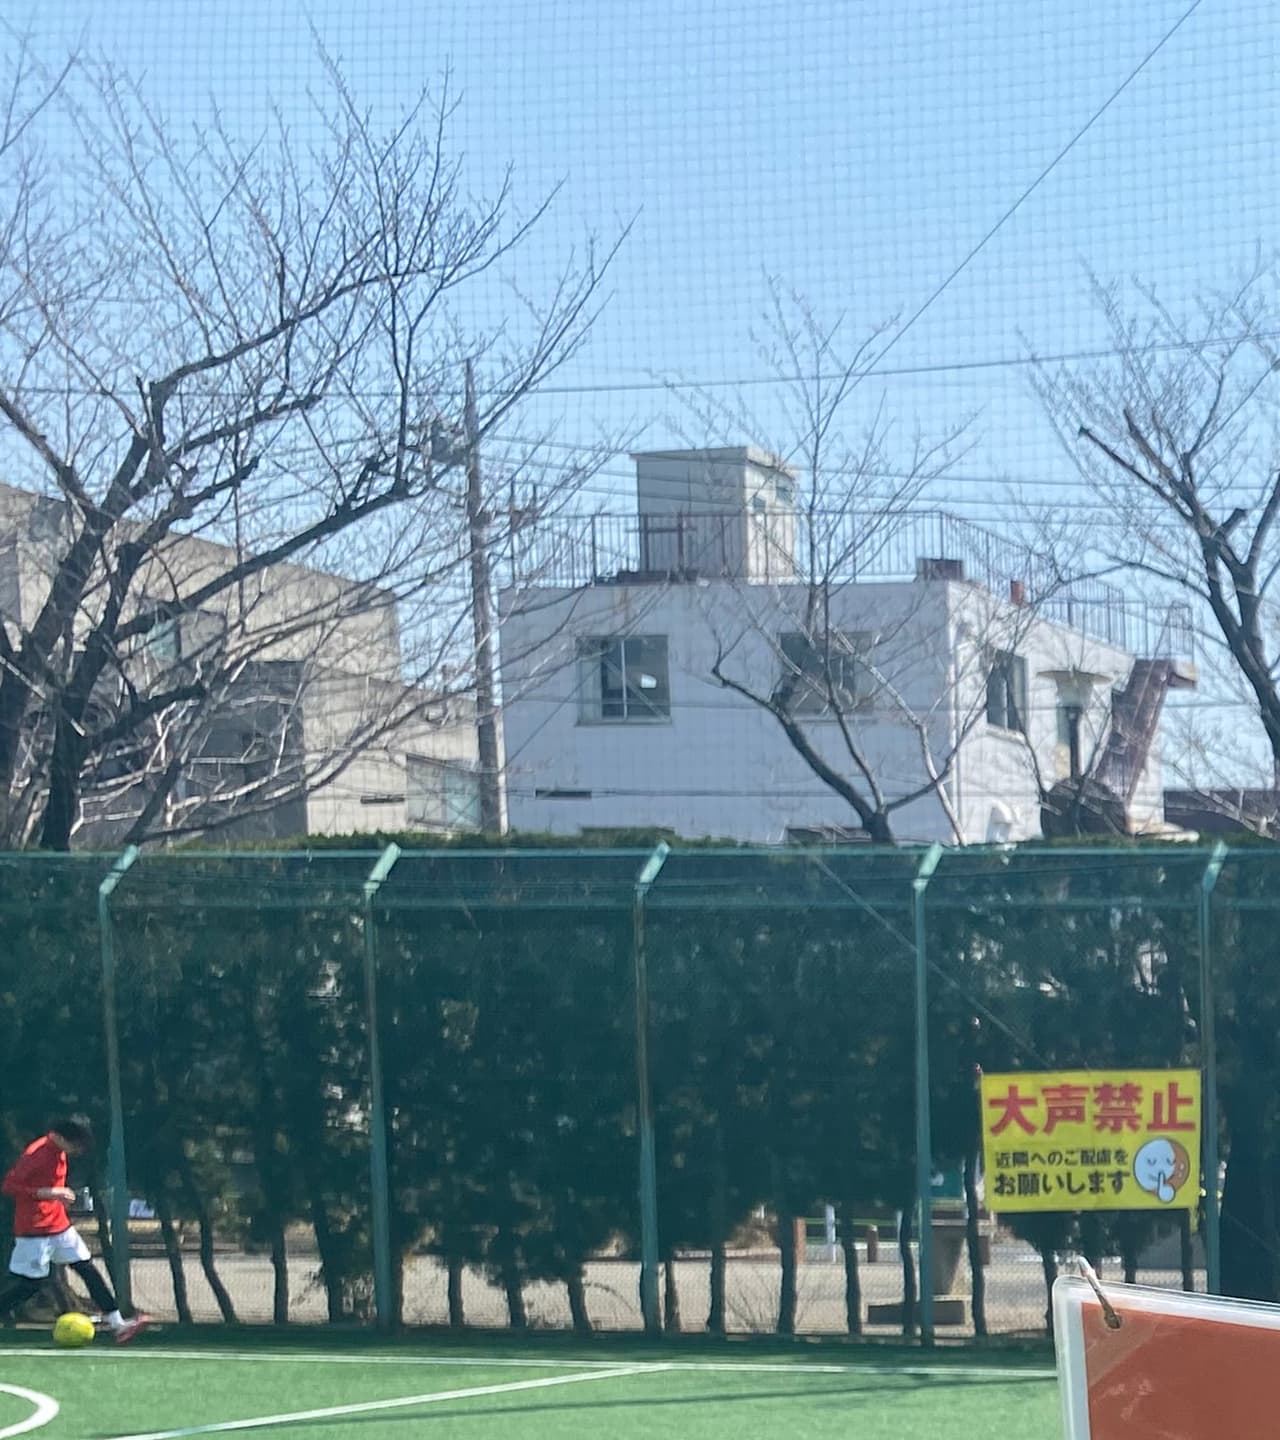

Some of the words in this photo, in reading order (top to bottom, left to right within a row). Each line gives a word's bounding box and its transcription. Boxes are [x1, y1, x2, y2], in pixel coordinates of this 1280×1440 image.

[989, 1082, 1196, 1135] 大声禁止
[995, 1149, 1129, 1169] 近隣へのご配慮を
[993, 1171, 1131, 1197] お願いします
